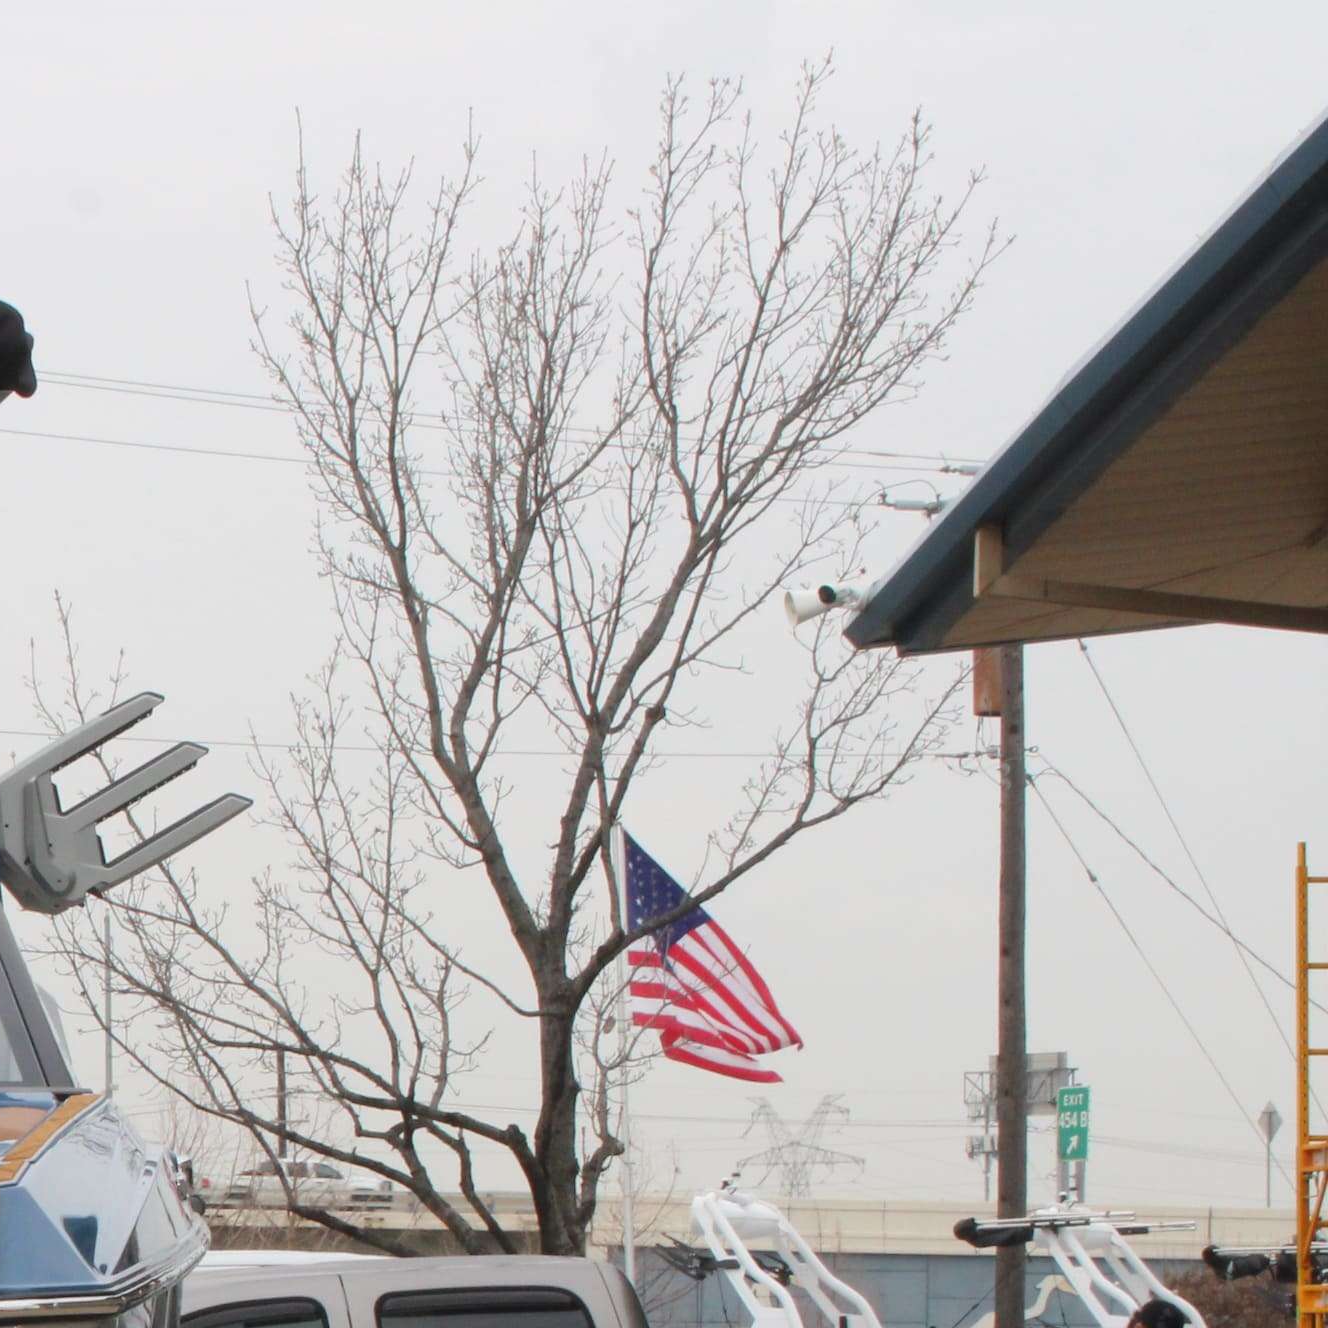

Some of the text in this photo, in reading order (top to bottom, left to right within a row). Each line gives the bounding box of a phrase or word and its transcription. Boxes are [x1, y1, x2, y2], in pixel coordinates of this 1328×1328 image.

[1063, 1093, 1084, 1107] EXIT
[1059, 1110, 1088, 1129] 454 B
